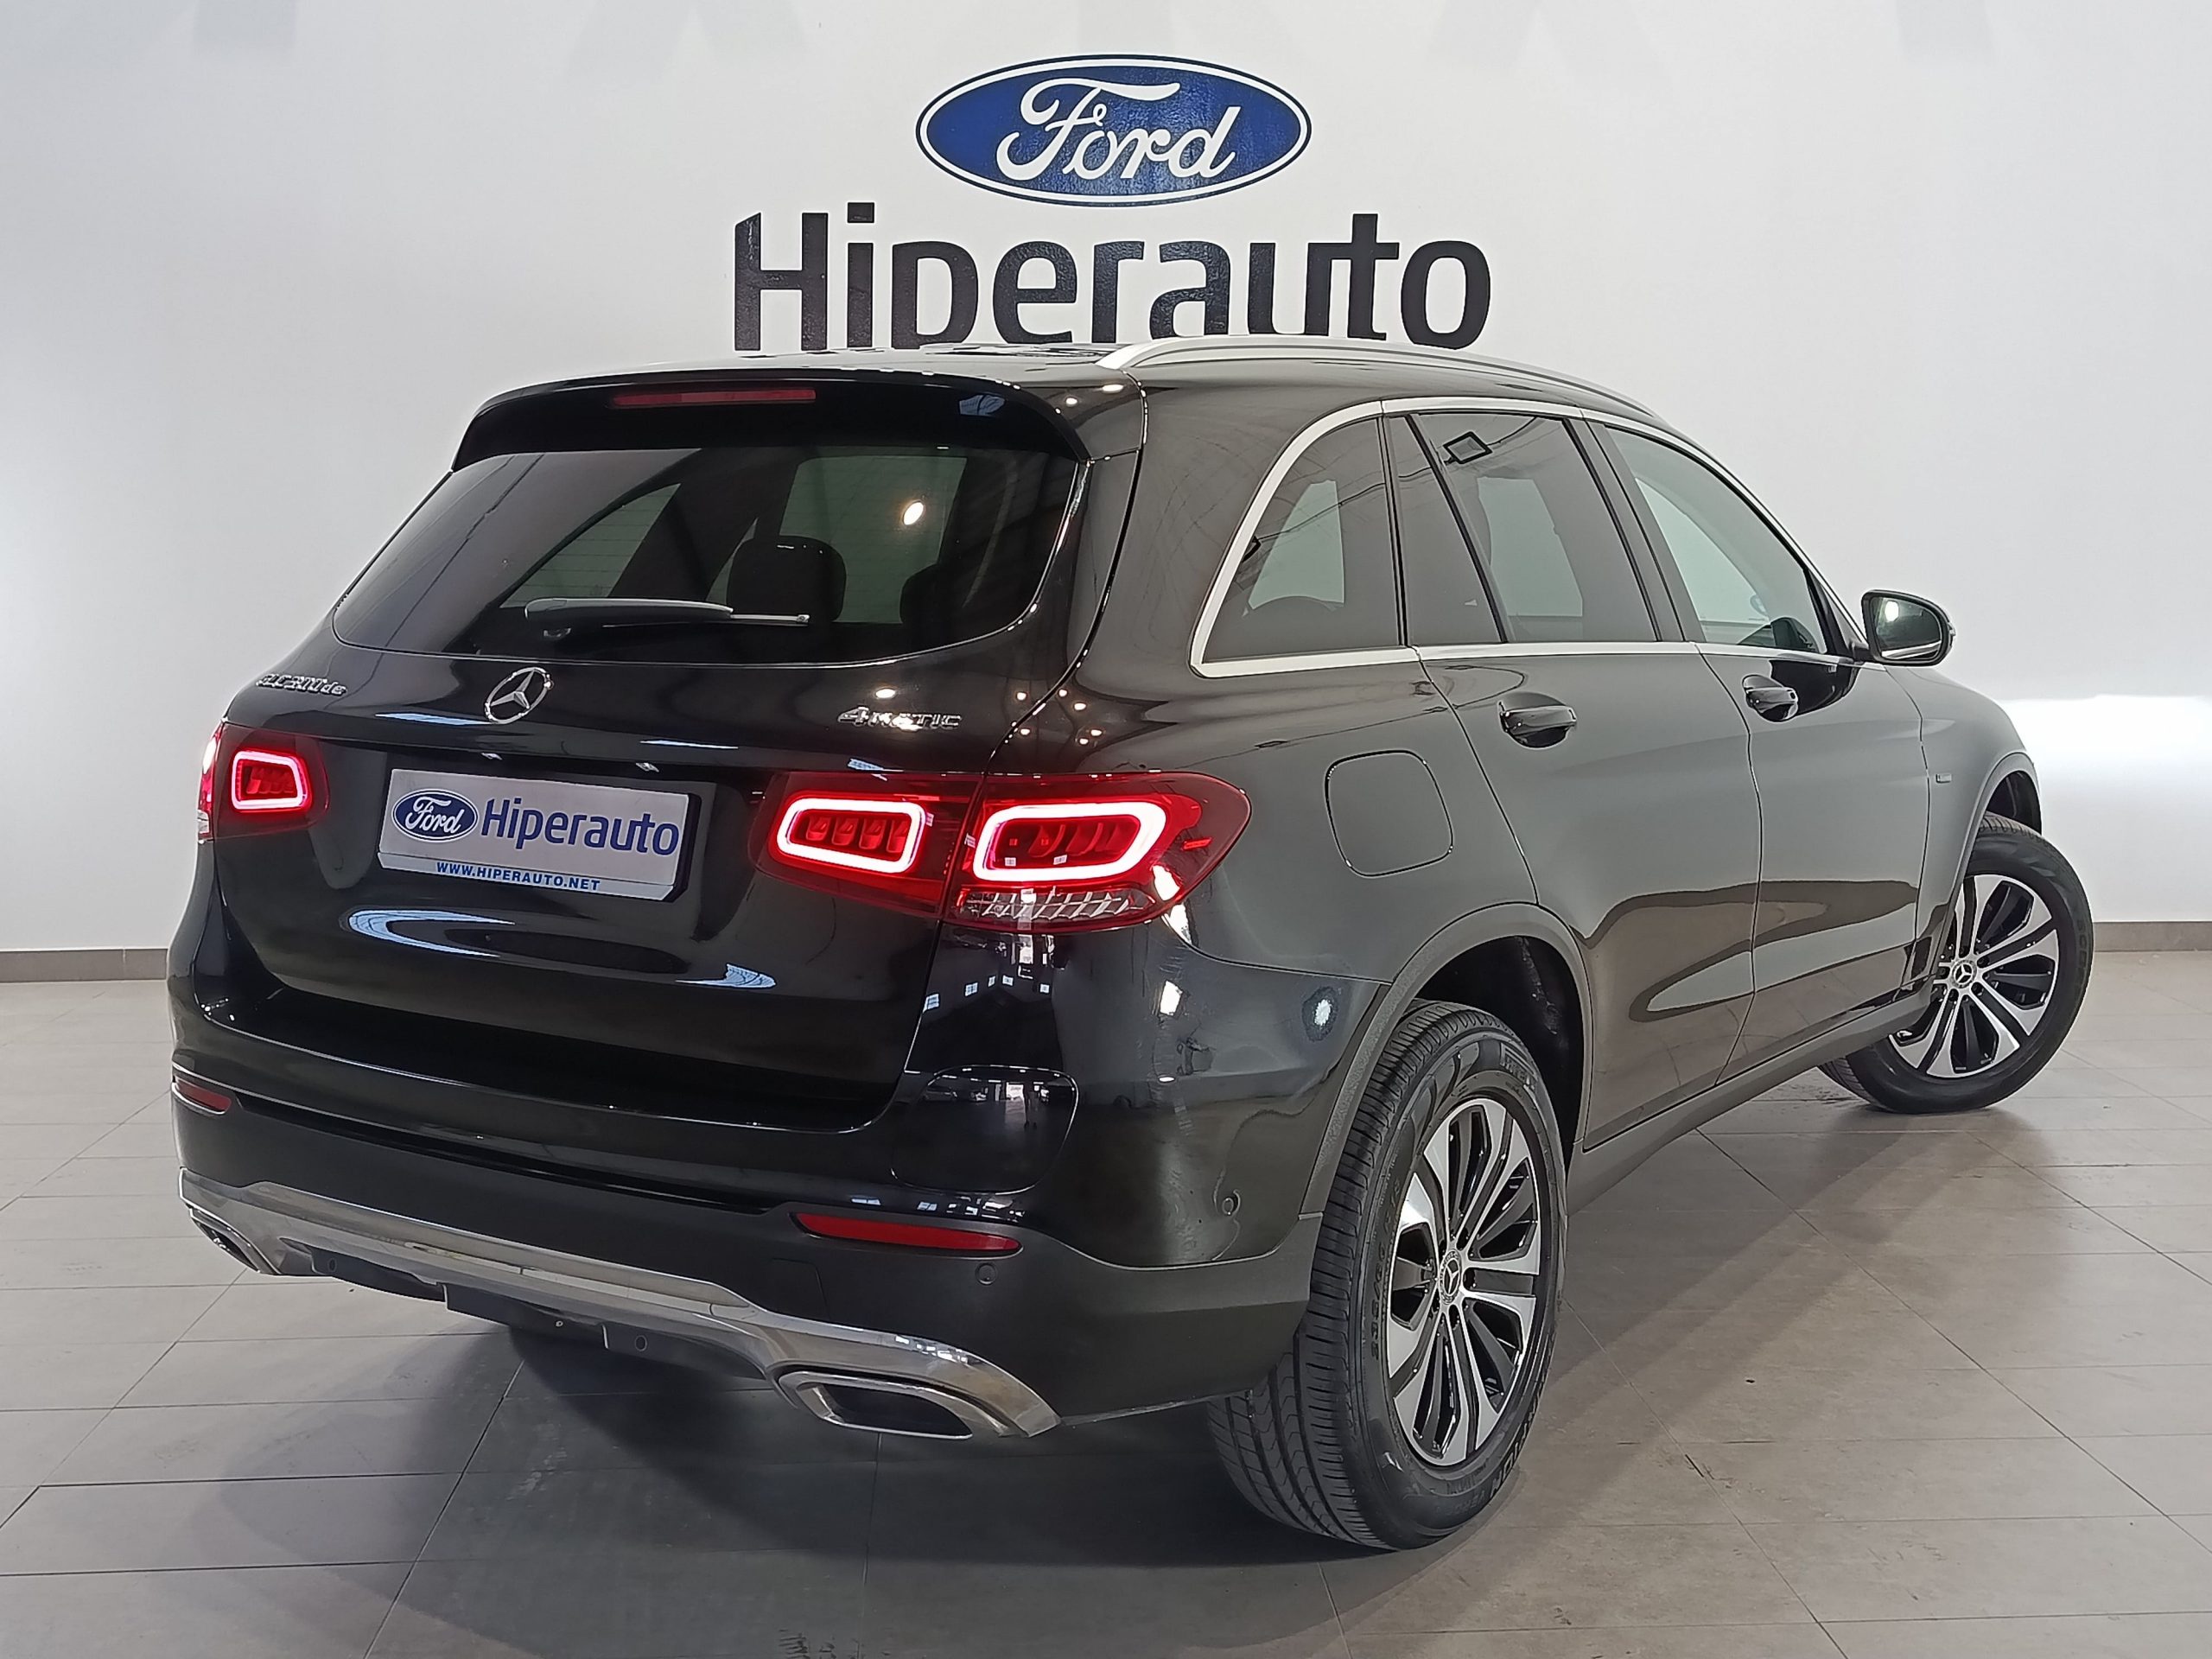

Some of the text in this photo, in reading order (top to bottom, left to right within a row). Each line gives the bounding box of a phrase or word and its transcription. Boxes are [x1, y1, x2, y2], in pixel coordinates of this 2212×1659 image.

[995, 76, 1242, 182] Ford
[733, 201, 1491, 352] Hiperauto
[404, 795, 680, 856] Ford Hiperauto
[436, 861, 601, 891] WWW.HIPERAUTO.NET
